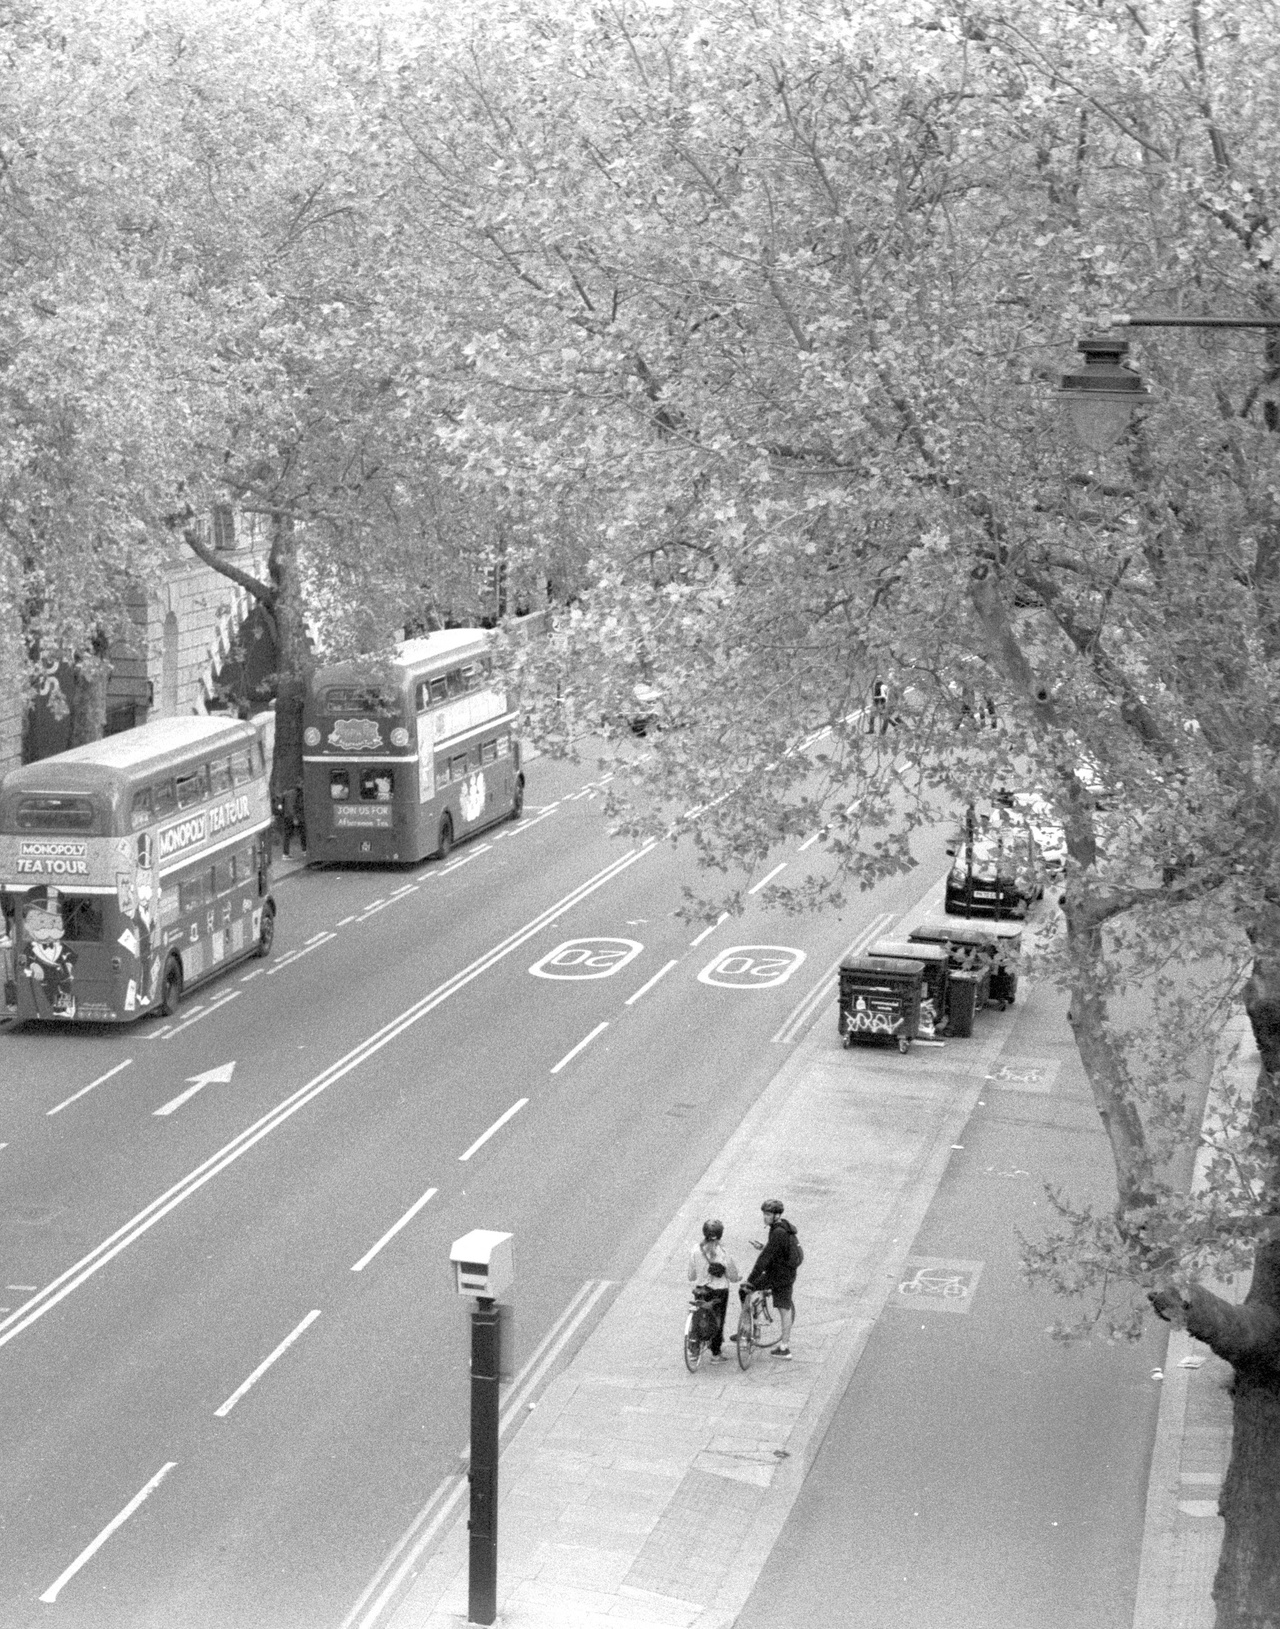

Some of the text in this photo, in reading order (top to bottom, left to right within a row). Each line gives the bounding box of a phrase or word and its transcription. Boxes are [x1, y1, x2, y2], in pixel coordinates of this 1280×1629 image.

[337, 806, 388, 815] JOIN US FOR
[159, 795, 250, 856] MONOPOLY TEA TOUR
[22, 844, 85, 855] MONOPOLY
[17, 859, 89, 874] TEA TOUR
[551, 949, 628, 967] 20
[716, 957, 792, 977] 20
